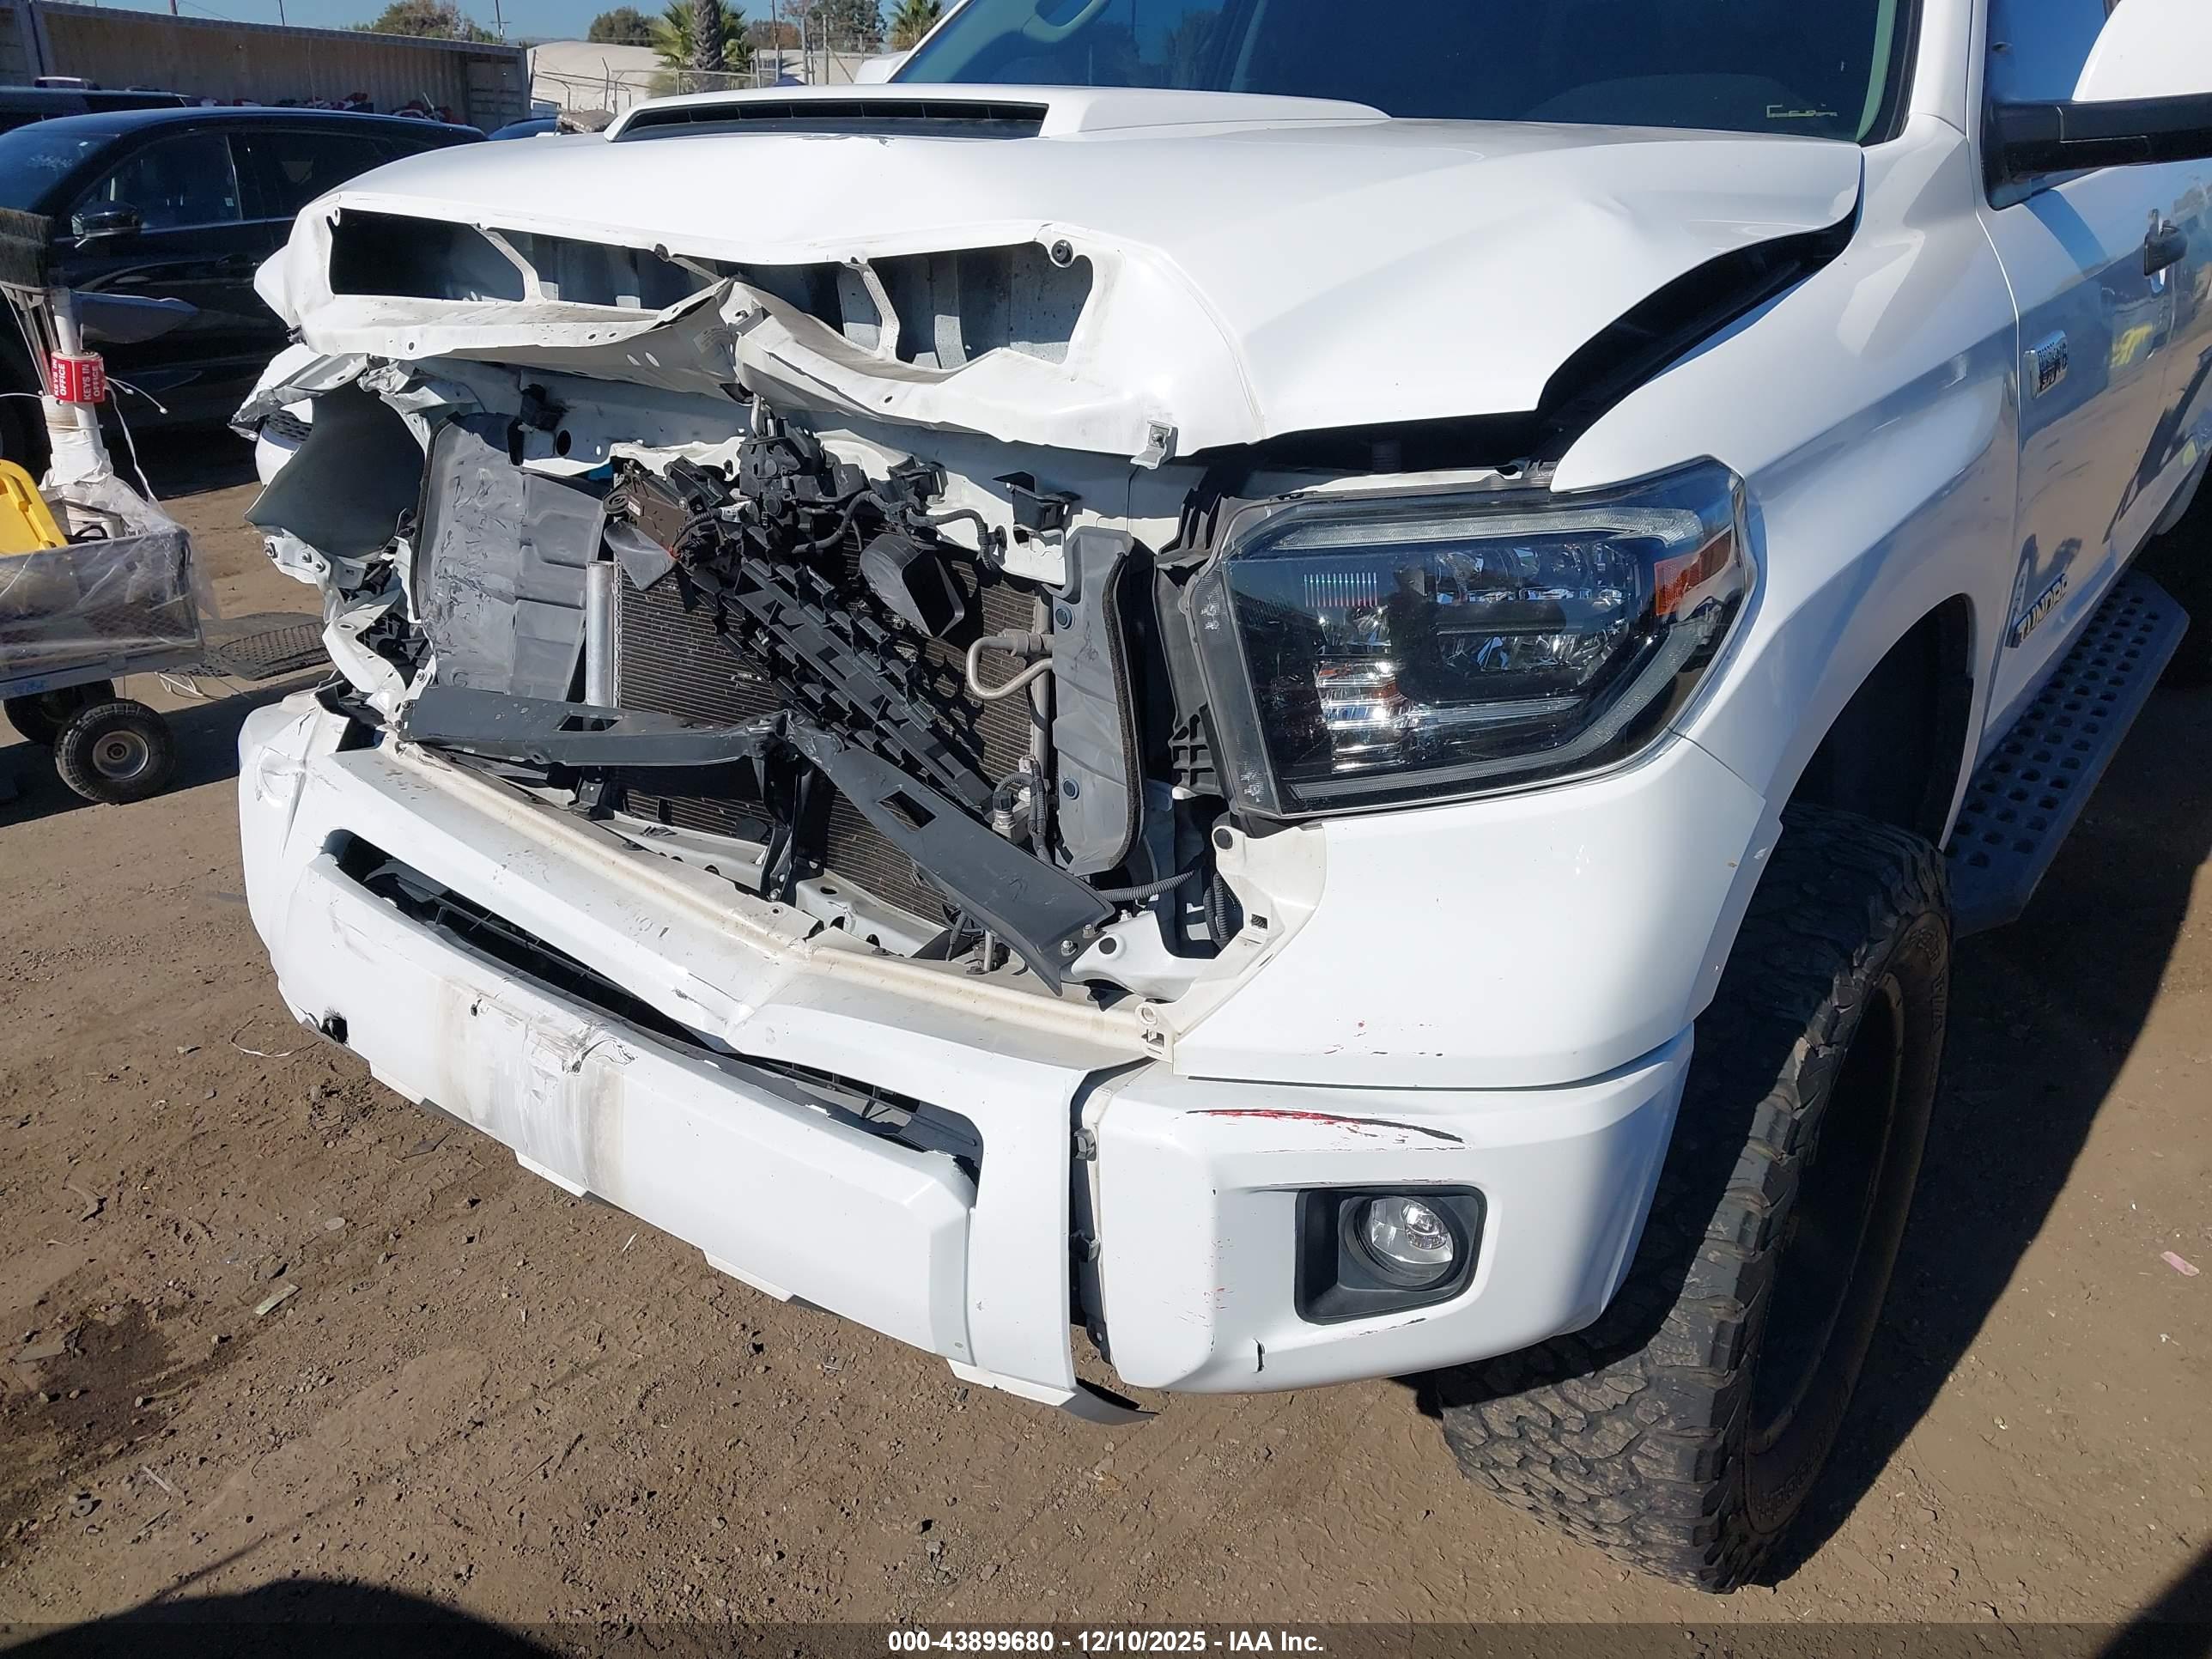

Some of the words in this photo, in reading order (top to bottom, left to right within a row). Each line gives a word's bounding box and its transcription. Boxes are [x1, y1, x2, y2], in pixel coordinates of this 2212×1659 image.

[52, 359, 58, 369] IN
[82, 364, 89, 374] IN
[82, 376, 91, 400] KEYS
[92, 365, 100, 397] OFFICE
